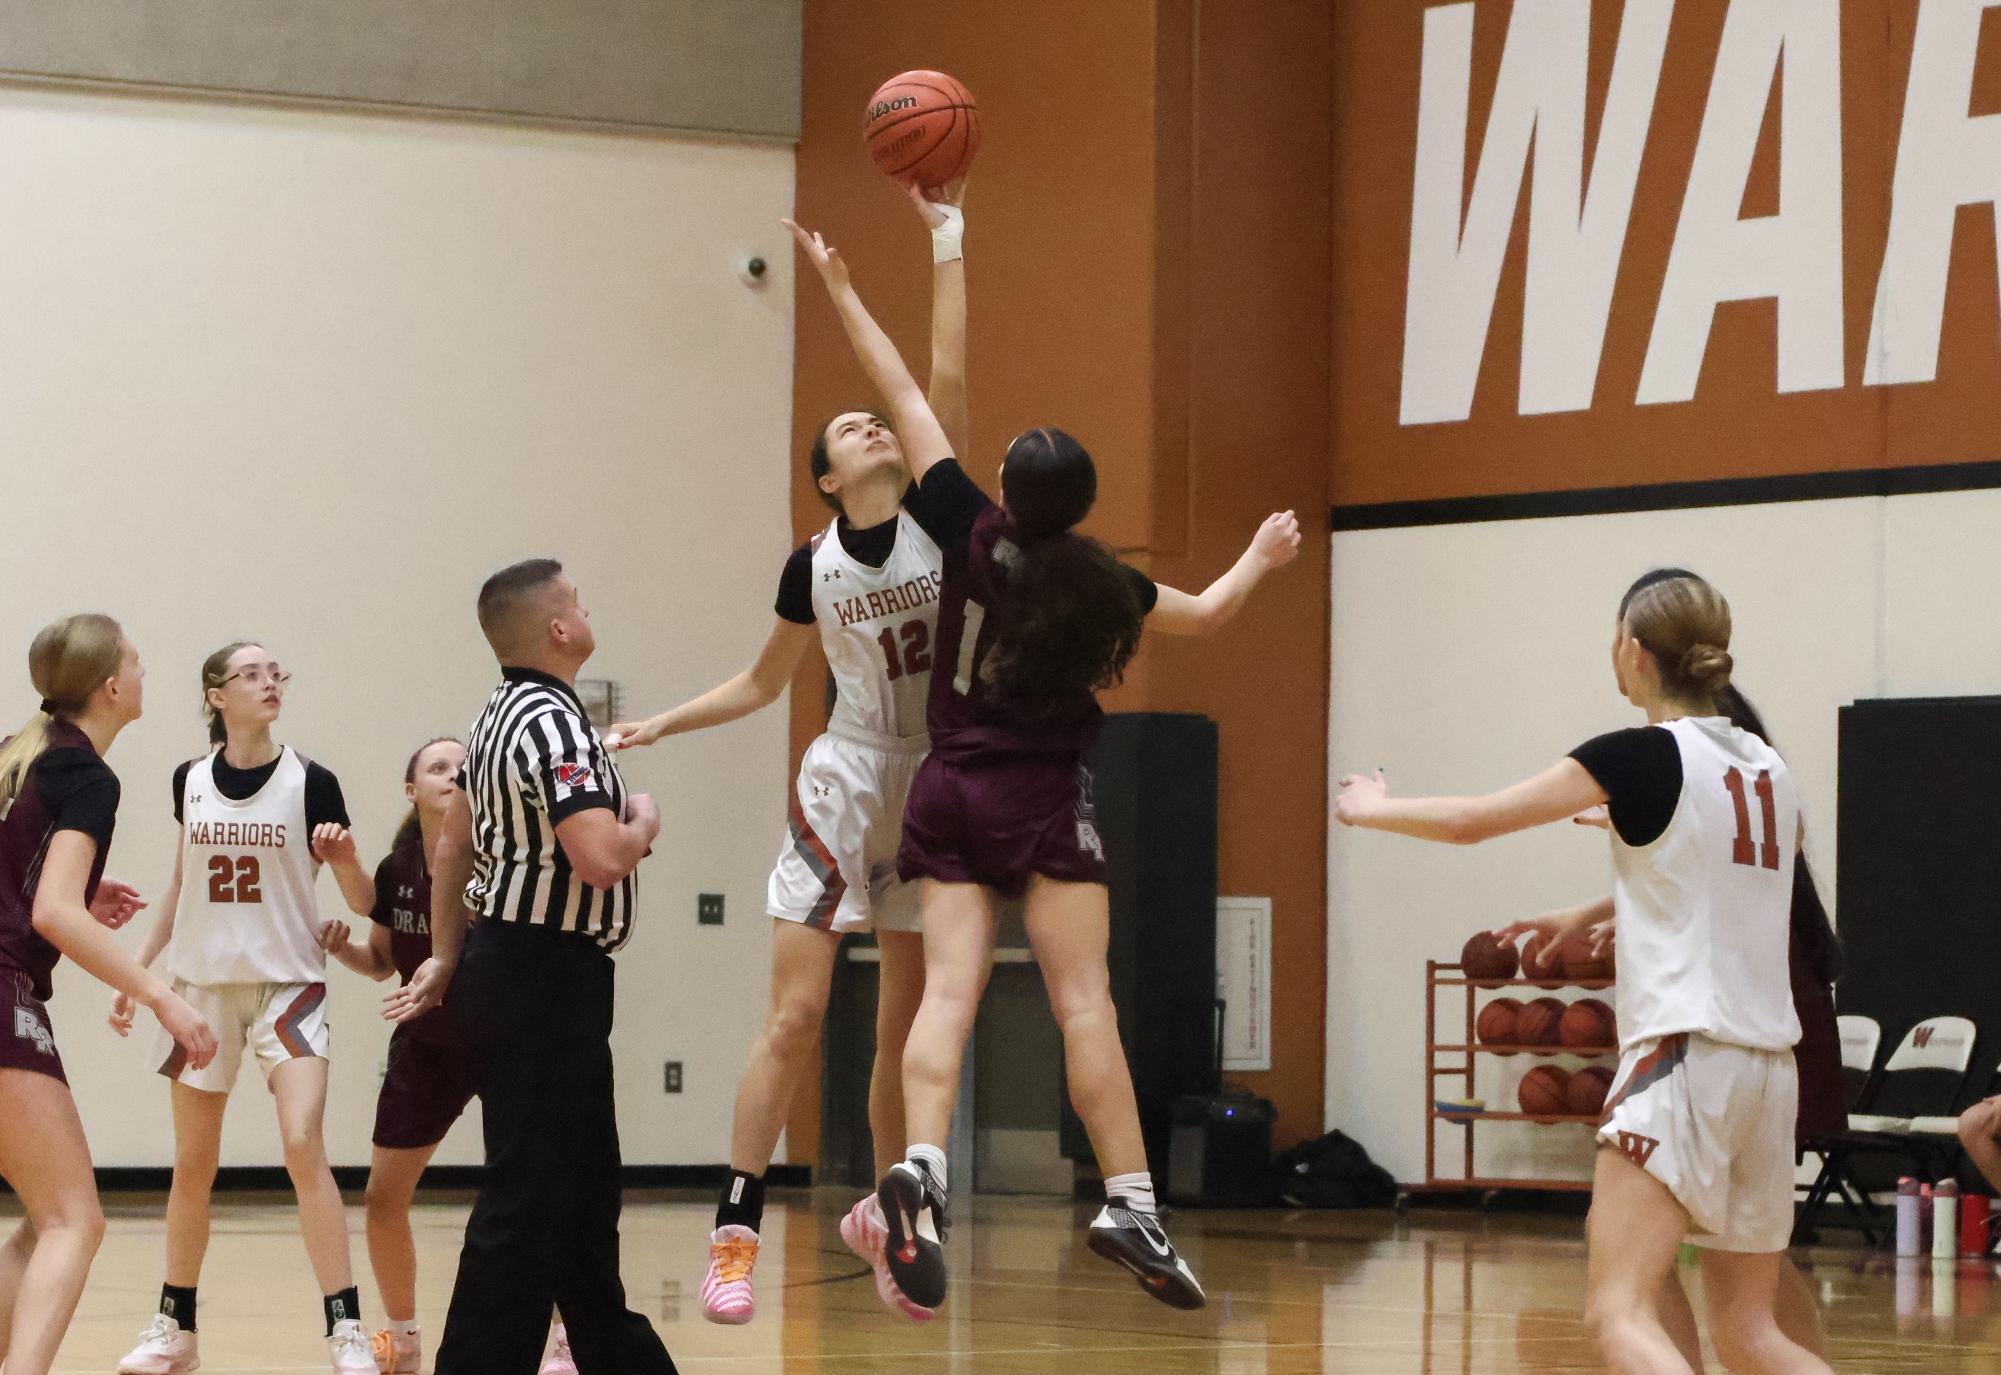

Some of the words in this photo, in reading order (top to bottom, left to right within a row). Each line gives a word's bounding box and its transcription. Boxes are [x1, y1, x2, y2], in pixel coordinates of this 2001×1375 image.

[877, 619, 932, 682] 12
[190, 821, 286, 848] WARRIORS
[1723, 764, 1780, 871] 11
[207, 854, 263, 904] 22
[1617, 1129, 1660, 1169] W
